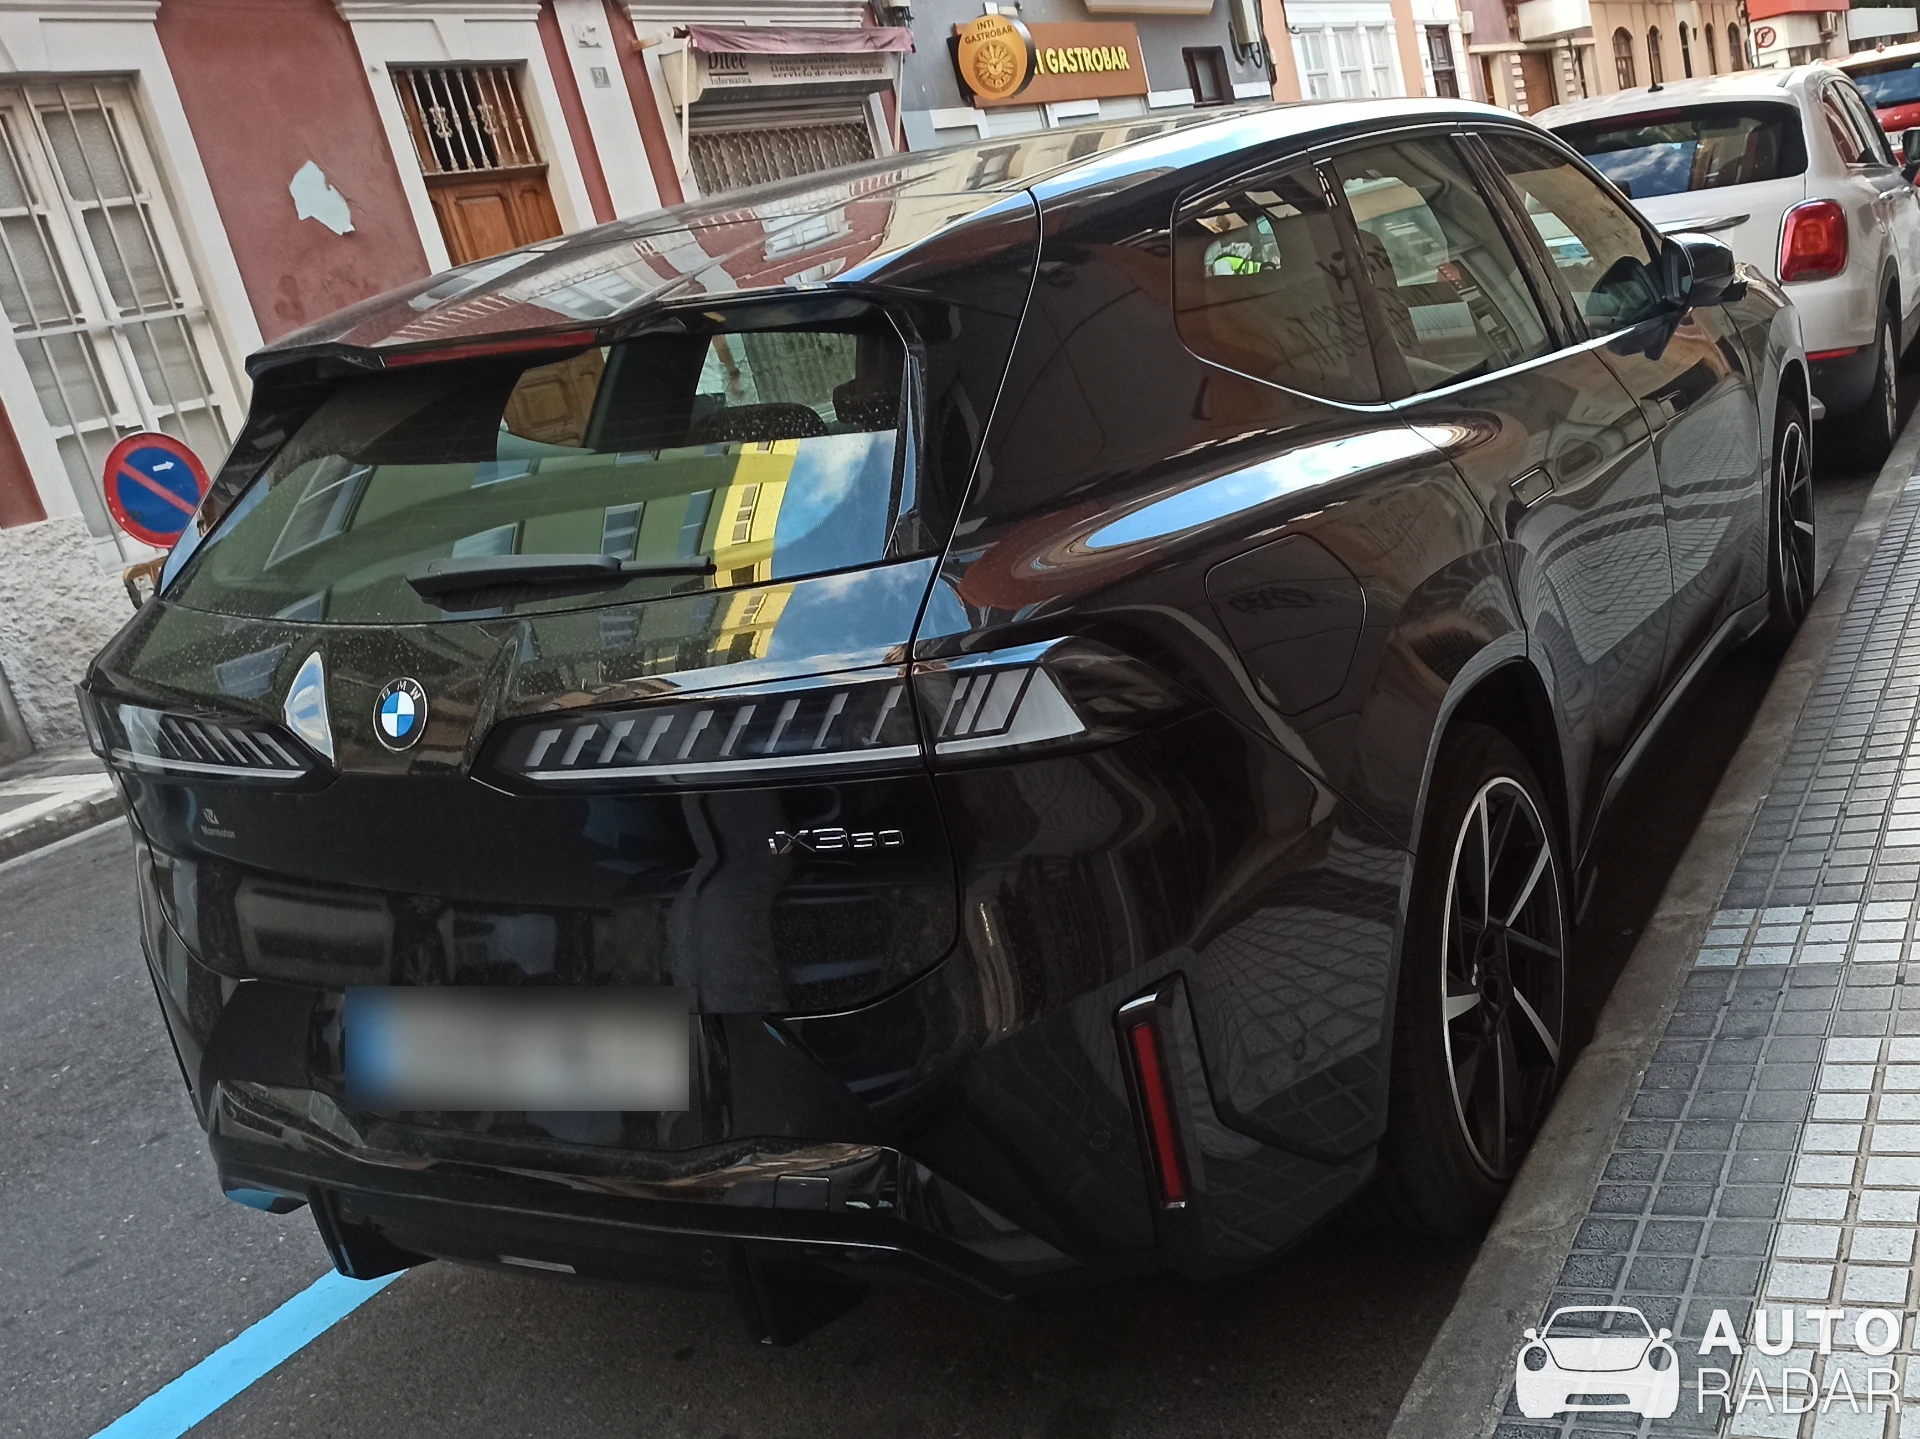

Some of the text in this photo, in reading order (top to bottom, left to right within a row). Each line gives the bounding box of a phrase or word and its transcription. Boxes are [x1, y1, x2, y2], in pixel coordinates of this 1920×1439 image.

[977, 19, 995, 31] INTI
[964, 25, 1014, 45] GASTROBAR
[708, 52, 746, 69] Ditec
[1045, 45, 1131, 75] GASTROBAR
[772, 69, 813, 78] servicio
[814, 69, 826, 77] de
[828, 68, 859, 77] copias
[381, 680, 421, 701] BMW
